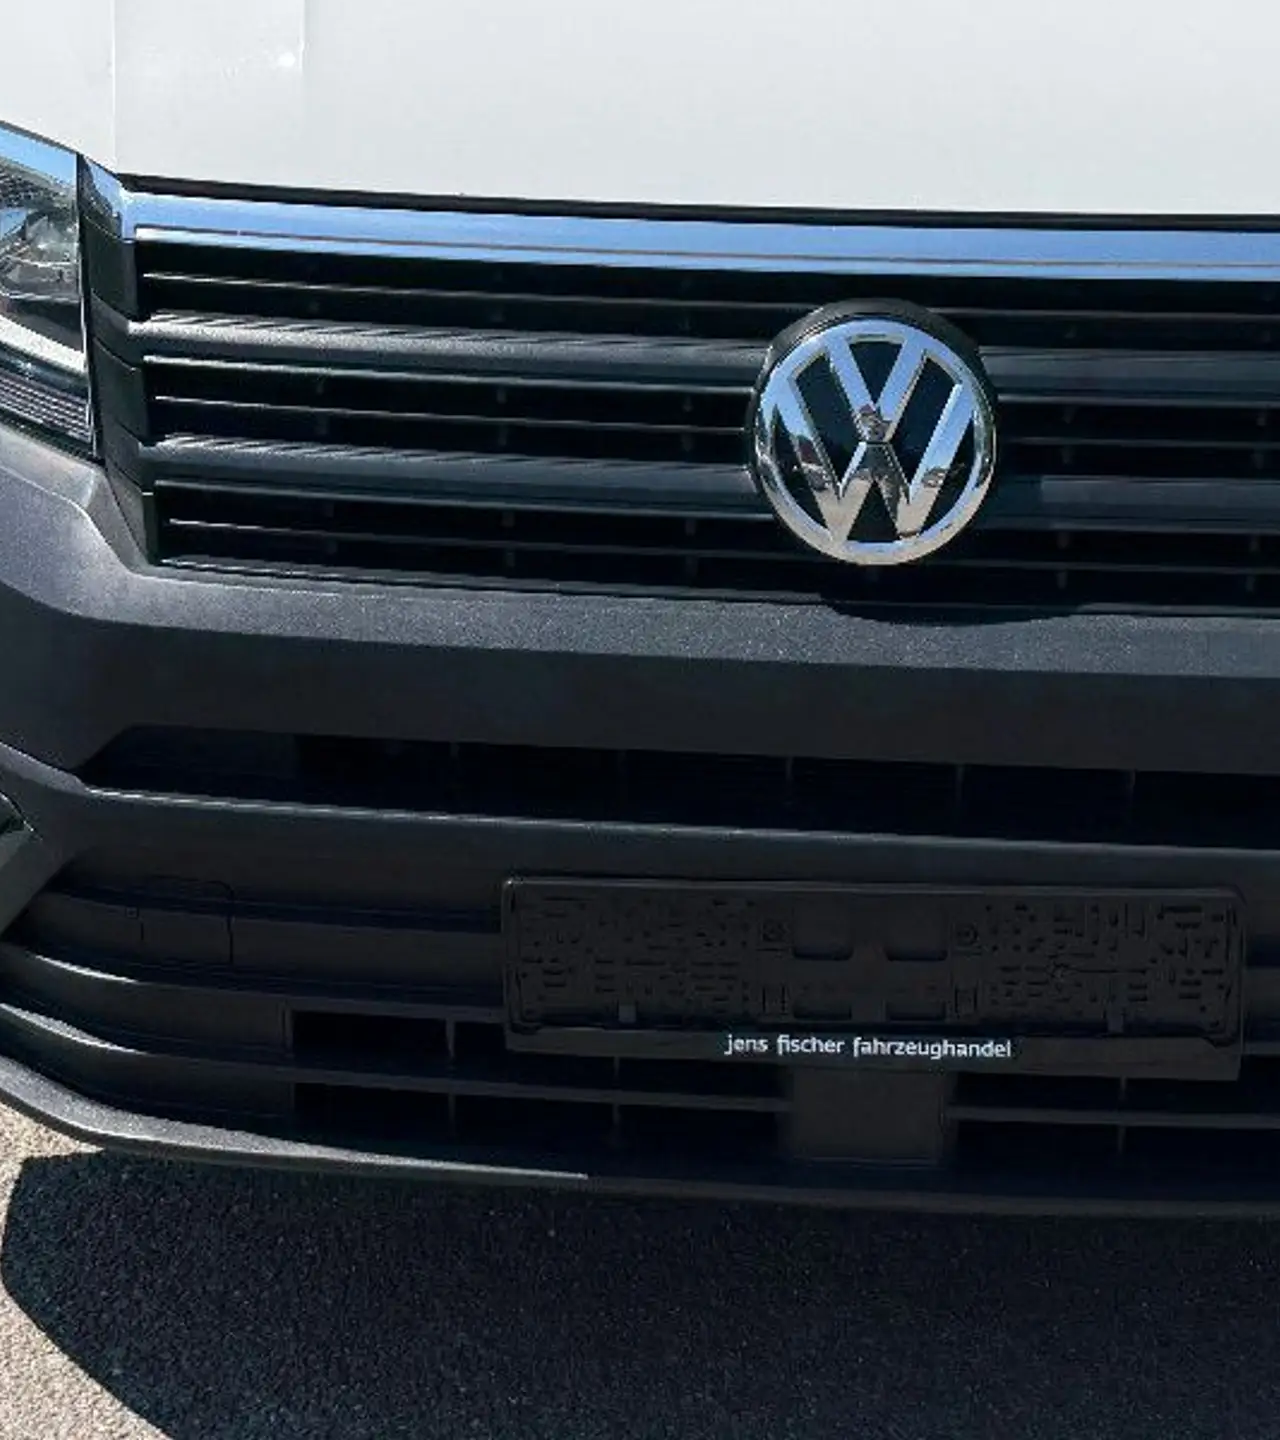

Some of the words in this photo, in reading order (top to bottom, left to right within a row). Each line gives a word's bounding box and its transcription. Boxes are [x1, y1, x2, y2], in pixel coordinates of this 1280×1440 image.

[723, 1033, 768, 1055] jens
[776, 1034, 845, 1055] fischer
[852, 1036, 1012, 1060] fahrzeughandel
